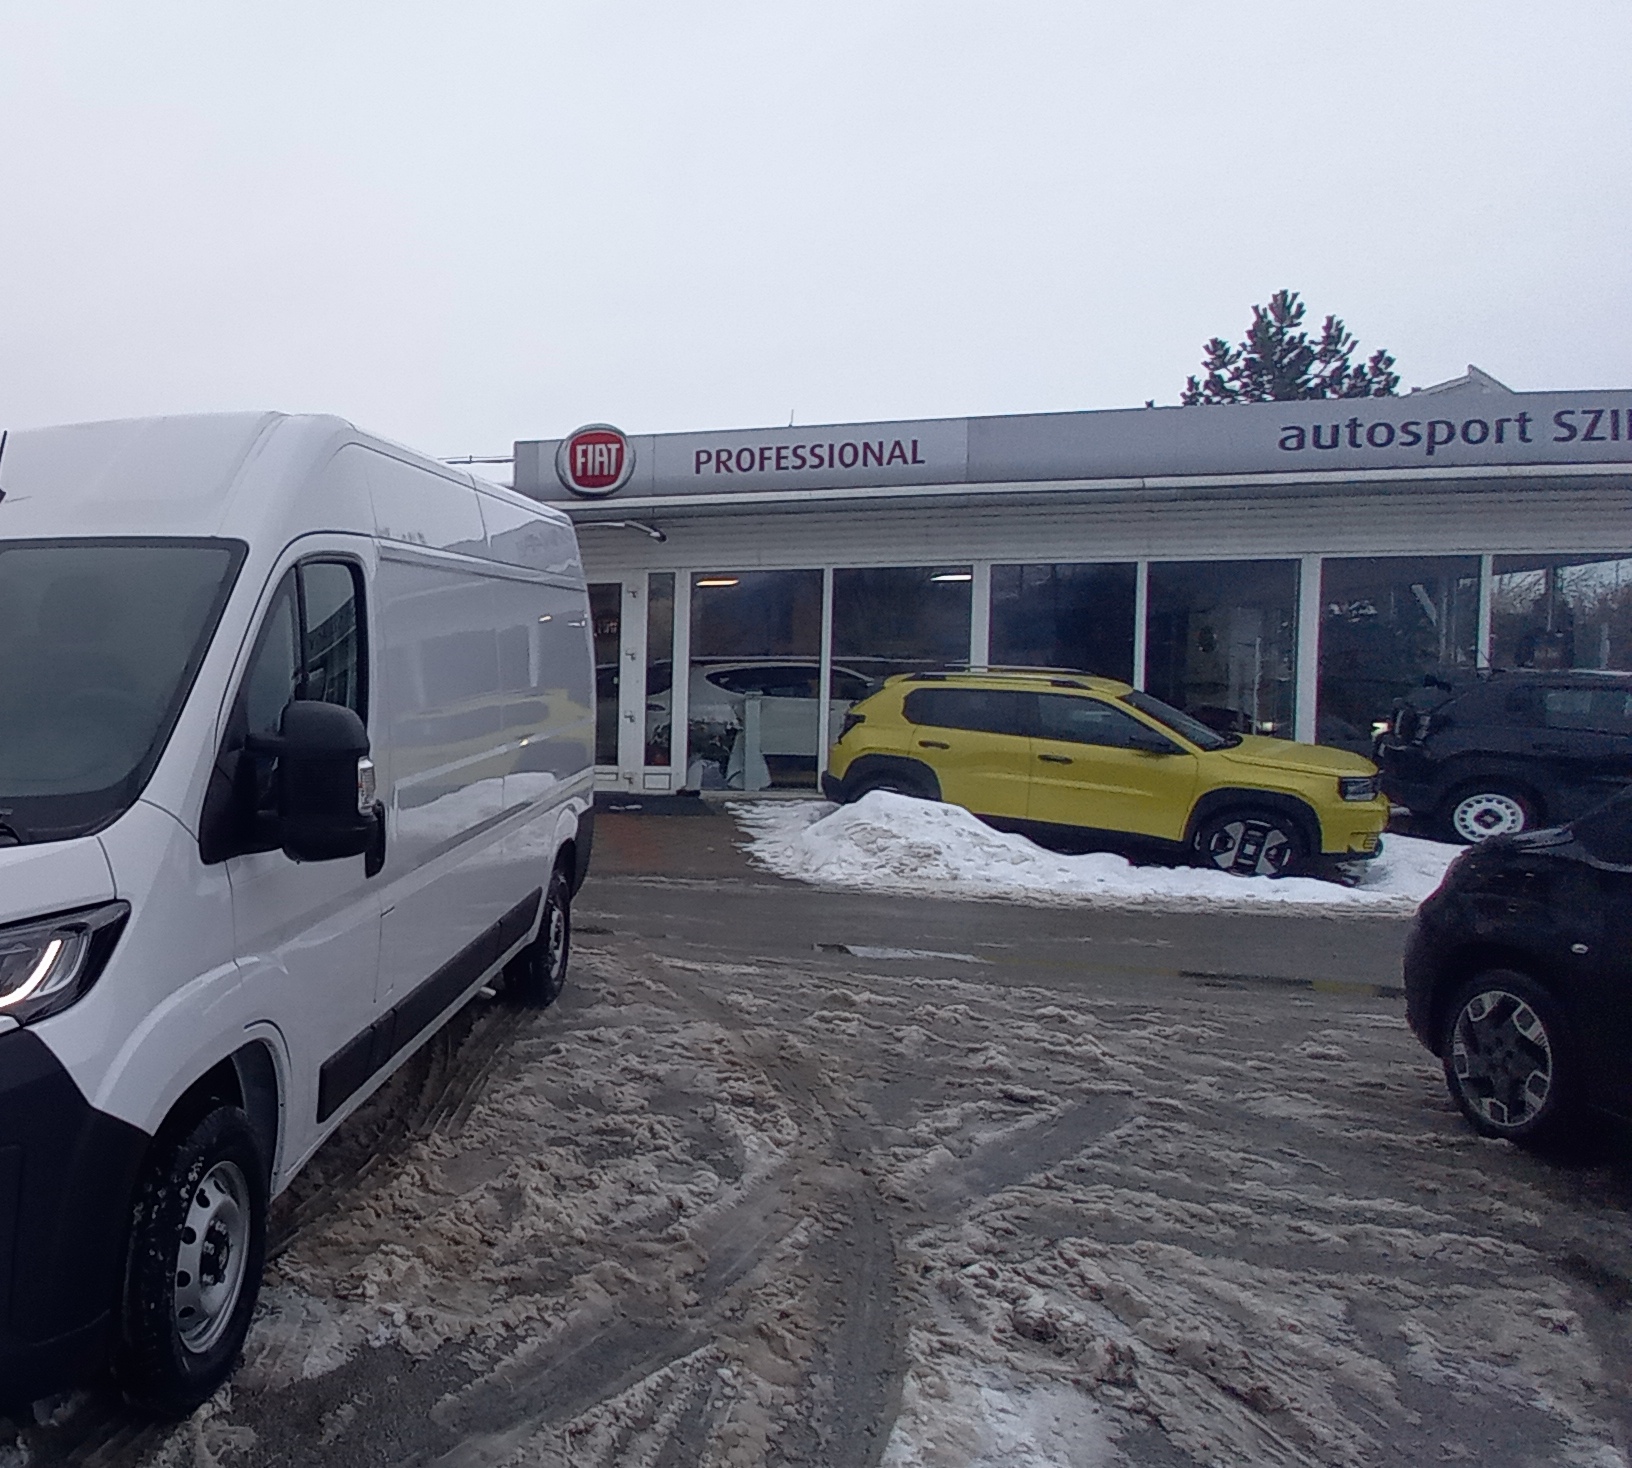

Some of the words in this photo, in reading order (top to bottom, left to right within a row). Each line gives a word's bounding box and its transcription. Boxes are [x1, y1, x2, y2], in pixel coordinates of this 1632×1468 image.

[1278, 411, 1533, 456] autosport
[1552, 408, 1632, 443] SZI
[575, 443, 621, 477] FIAT
[694, 439, 926, 475] PROFESSIONAL
